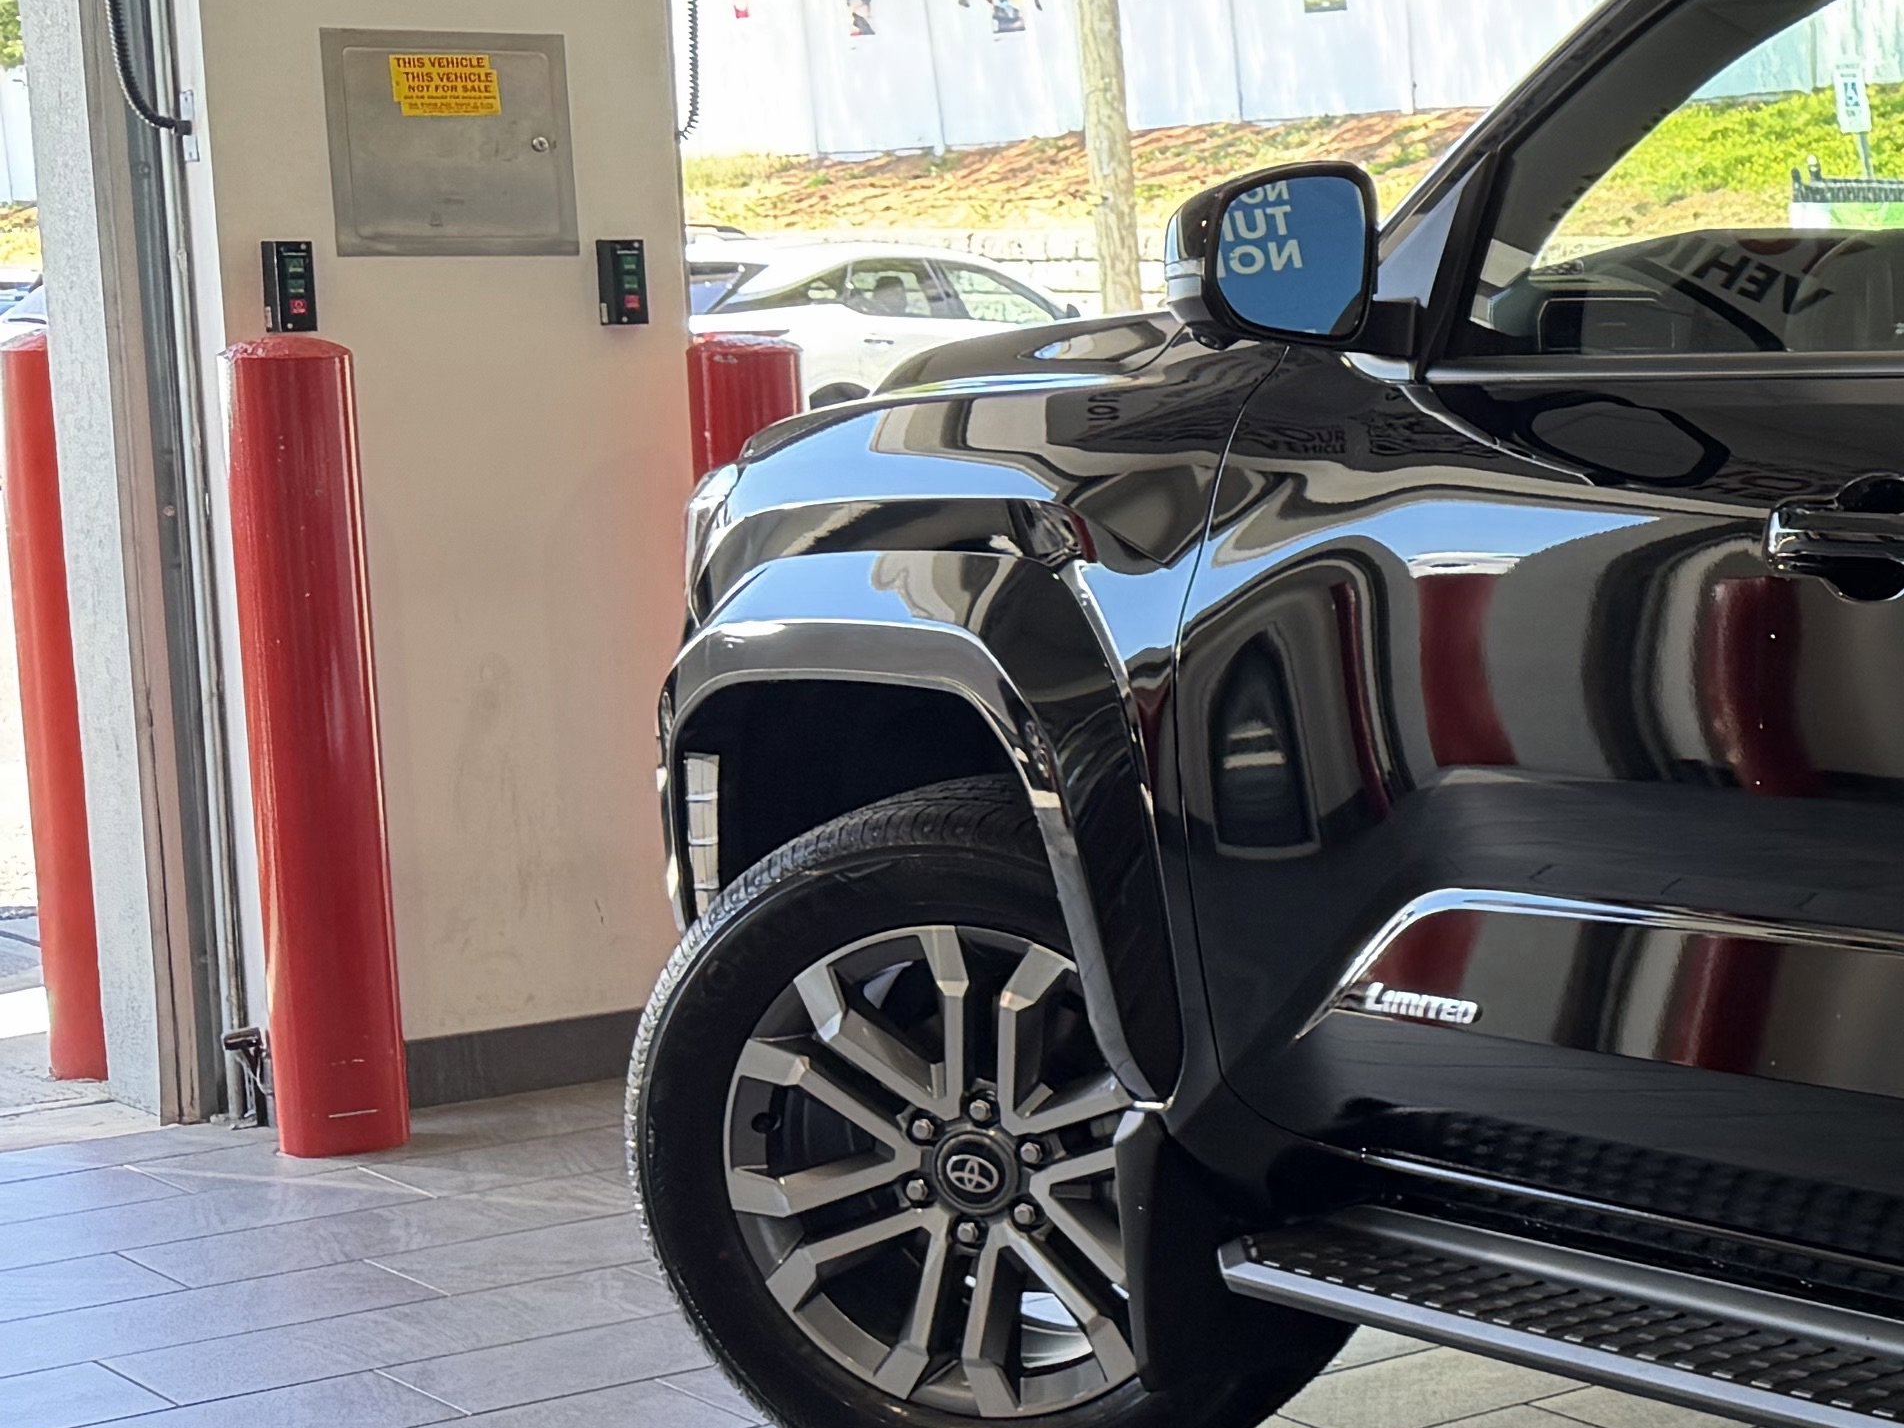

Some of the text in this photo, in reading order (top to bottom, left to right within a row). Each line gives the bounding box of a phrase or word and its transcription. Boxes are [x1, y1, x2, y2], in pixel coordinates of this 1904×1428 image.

[394, 56, 486, 69] THIS VEHICLE
[403, 71, 494, 84] THIS VEHICLE
[407, 84, 492, 93] NOT FOR SALE
